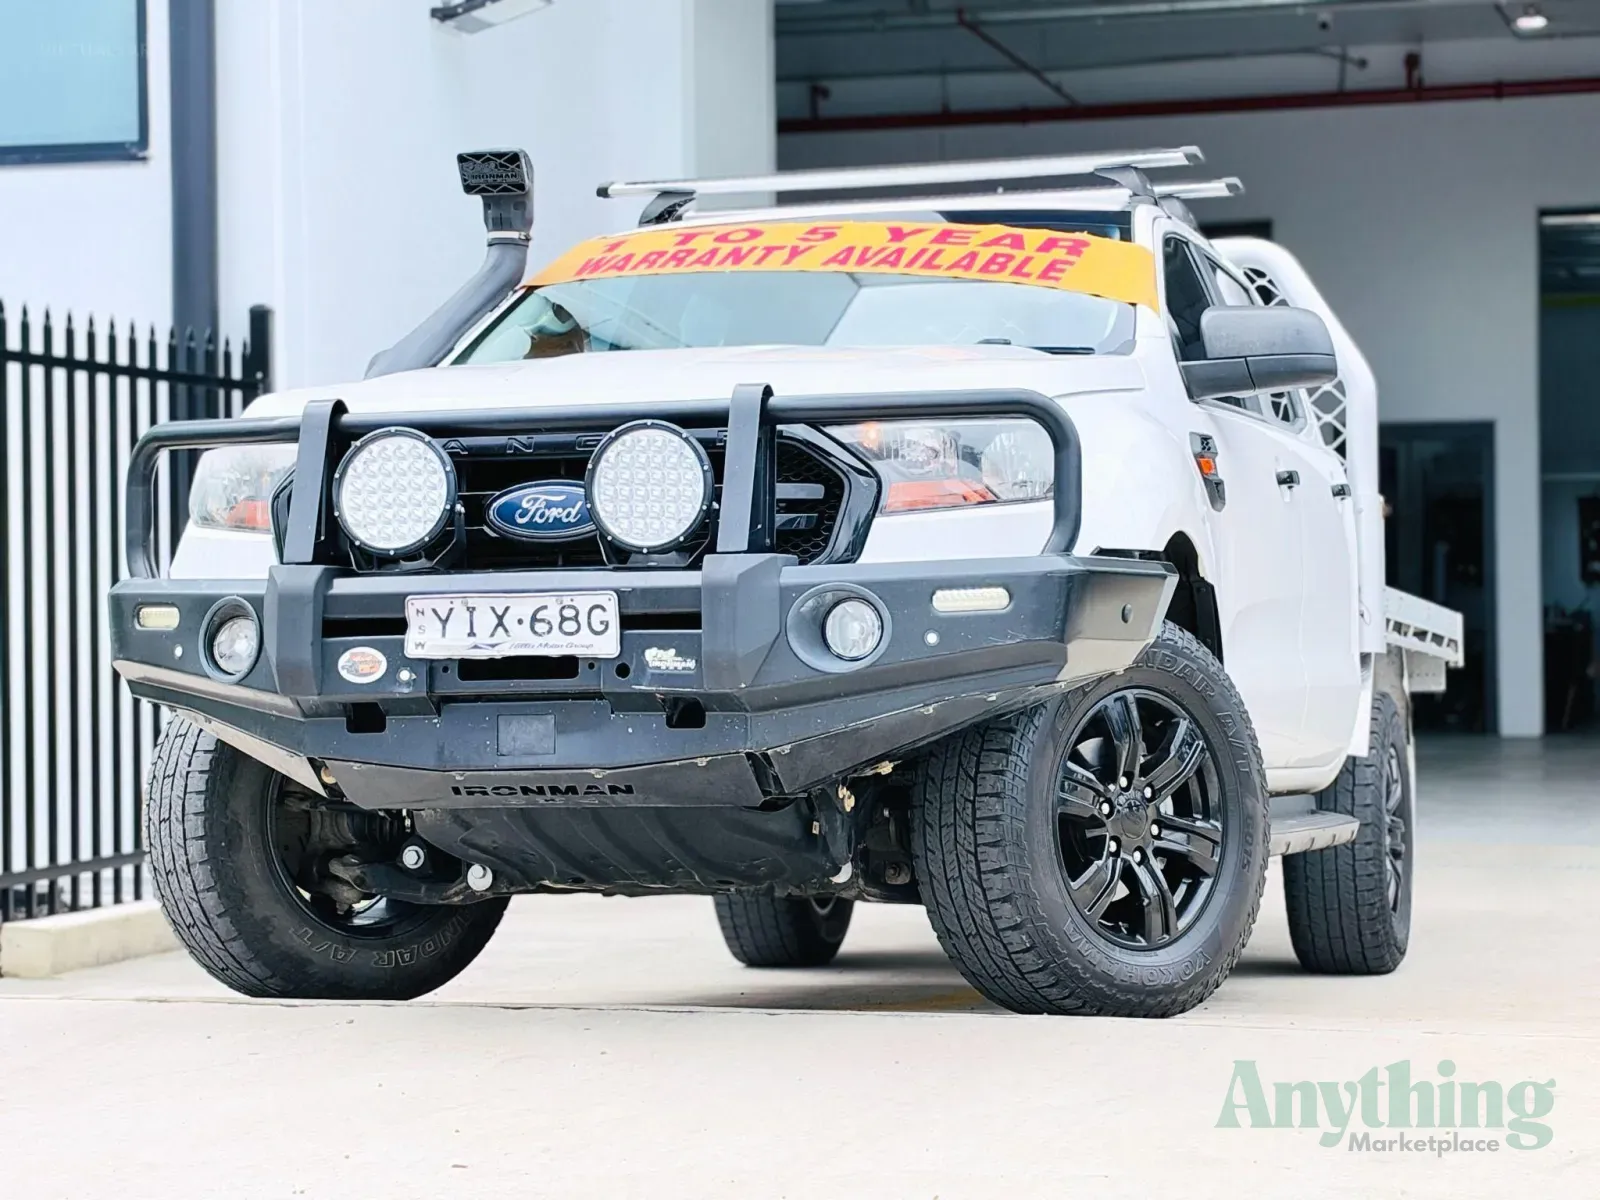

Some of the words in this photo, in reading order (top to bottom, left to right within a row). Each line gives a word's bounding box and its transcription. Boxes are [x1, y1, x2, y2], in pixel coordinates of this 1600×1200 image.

[600, 239, 629, 254] 1
[672, 228, 765, 247] TO
[795, 226, 842, 243] 5
[886, 226, 1092, 257] YEAR
[573, 245, 817, 277] WARRANTY
[820, 245, 1077, 282] AVAILABLE
[514, 494, 584, 525] Ford
[450, 784, 635, 797] IRONMAN
[1063, 917, 1213, 988] YOKOHAMA
